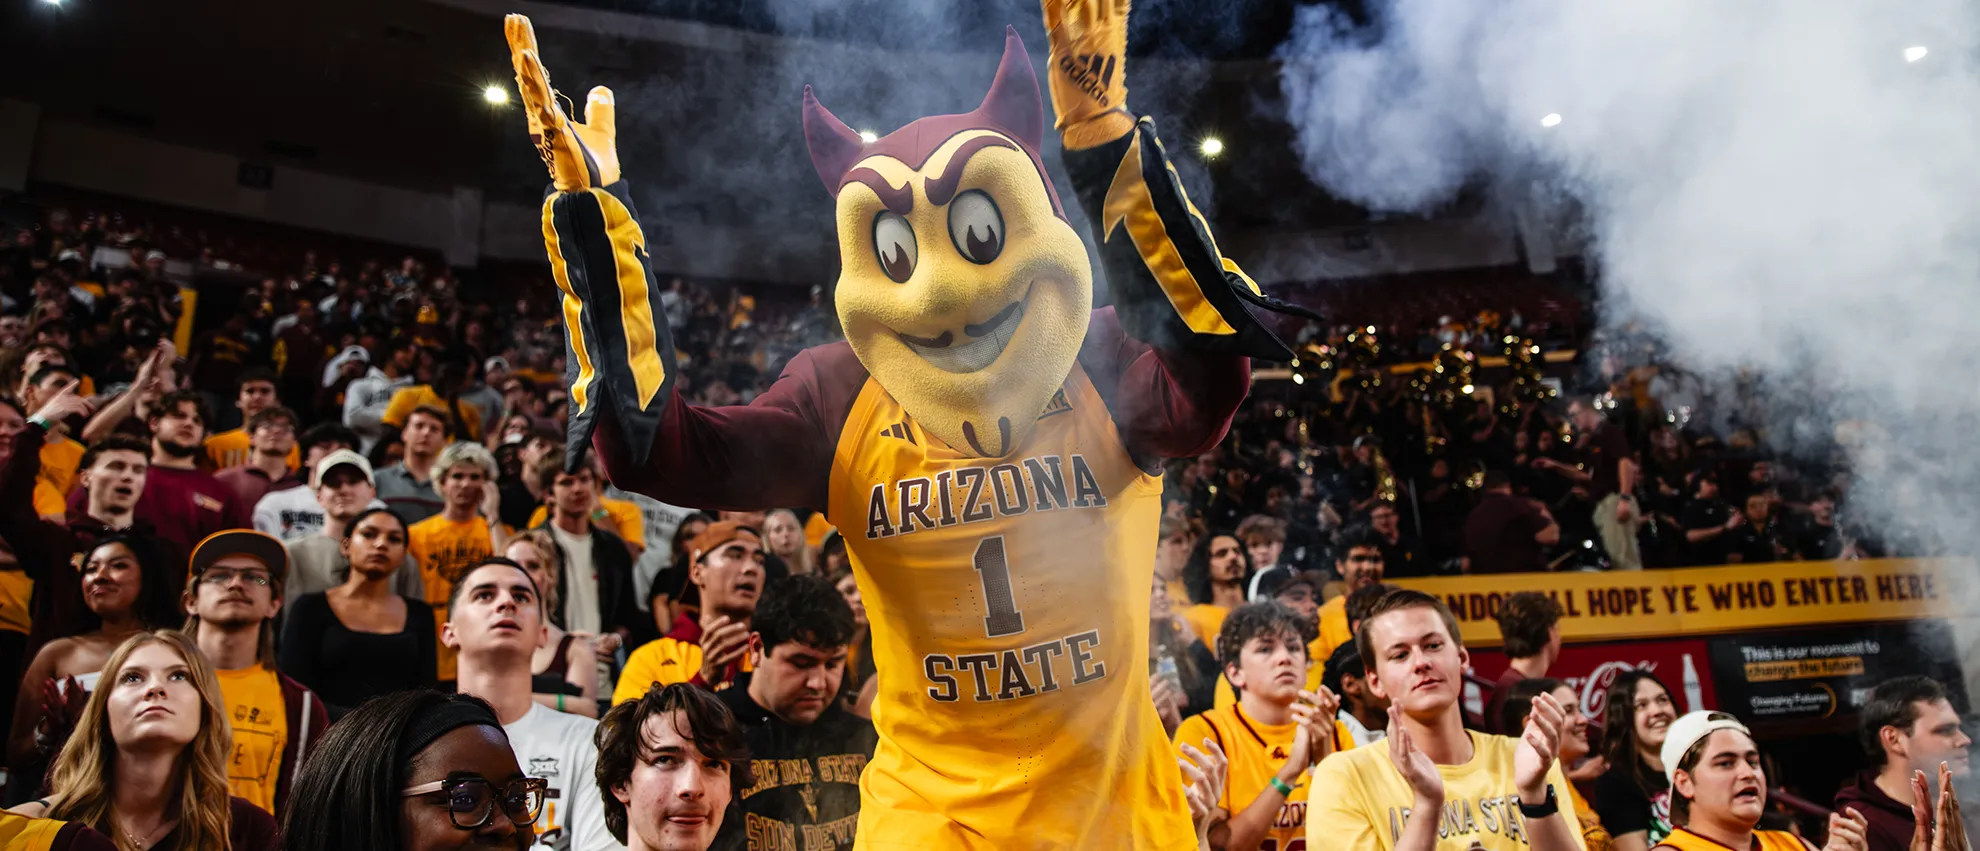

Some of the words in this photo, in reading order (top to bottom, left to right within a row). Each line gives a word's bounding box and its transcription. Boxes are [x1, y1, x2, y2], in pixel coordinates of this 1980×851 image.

[1060, 54, 1109, 108] adidas
[866, 454, 1108, 539] ARIZONA
[972, 534, 1026, 638] 1
[1586, 586, 1655, 617] HOPE
[1662, 584, 1700, 613] YE
[1705, 579, 1777, 611] WHO
[1783, 574, 1870, 607] ENTER
[1874, 571, 1940, 601] HERE
[923, 628, 1107, 702] STATE
[1741, 645, 1772, 662] This
[1773, 645, 1785, 660] is
[1786, 646, 1809, 659] our
[1810, 640, 1864, 657] moment
[1864, 639, 1881, 654] to
[741, 758, 814, 800] RIZONA
[745, 811, 797, 851] SUN
[801, 811, 860, 851] DEVI
